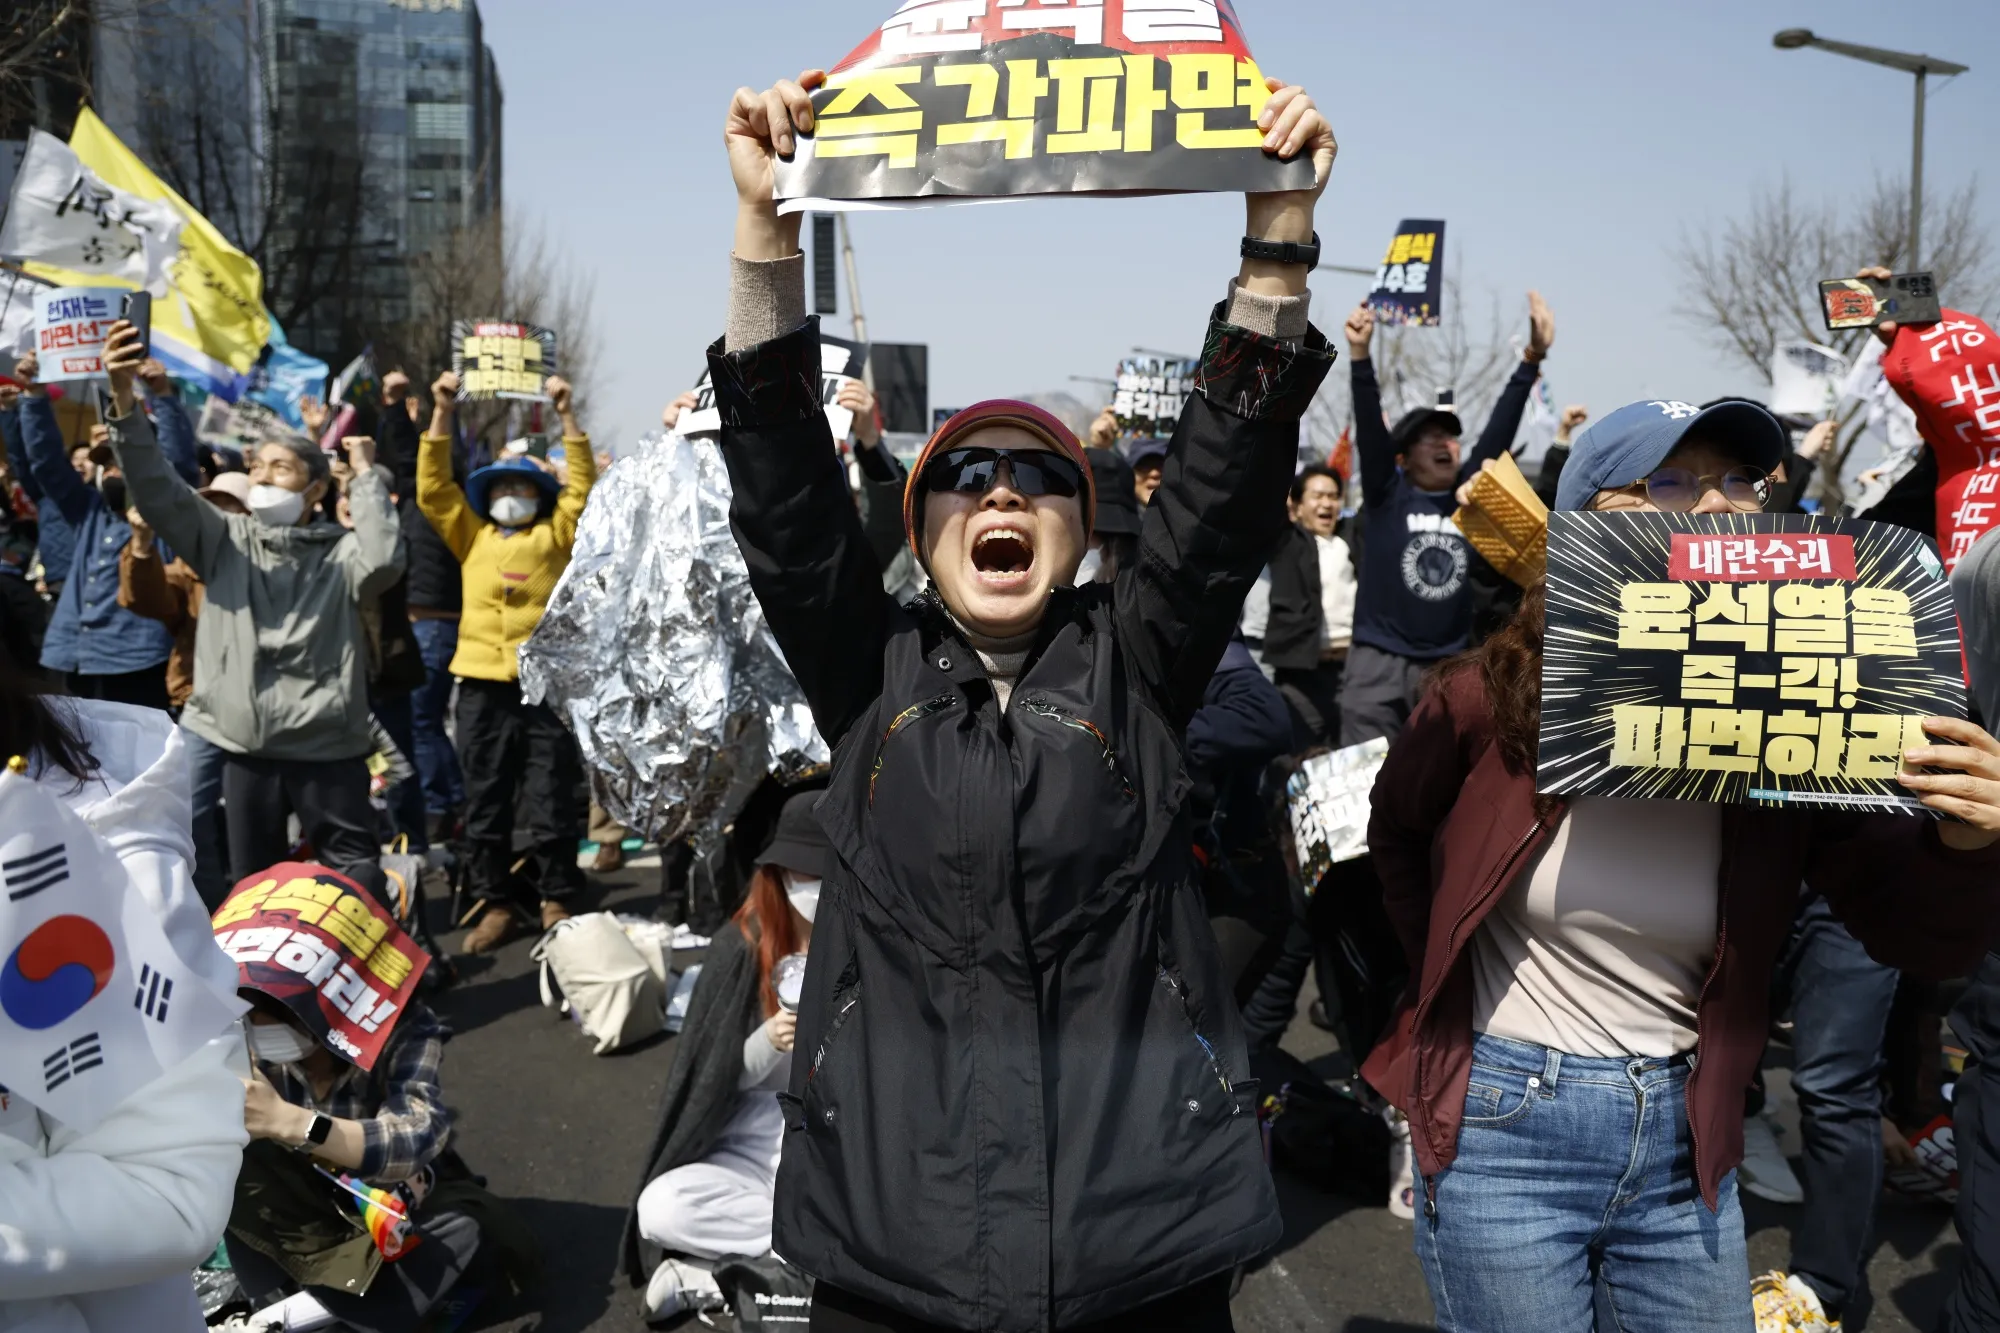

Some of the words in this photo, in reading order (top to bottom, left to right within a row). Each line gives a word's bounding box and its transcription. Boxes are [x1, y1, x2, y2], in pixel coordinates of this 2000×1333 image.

[815, 54, 1265, 168] 즉각파면
[1688, 538, 1833, 576] 내란수괴
[1617, 582, 1919, 658] 윤석열을
[214, 926, 398, 1034] 면하라!
[755, 1292, 771, 1305] The
